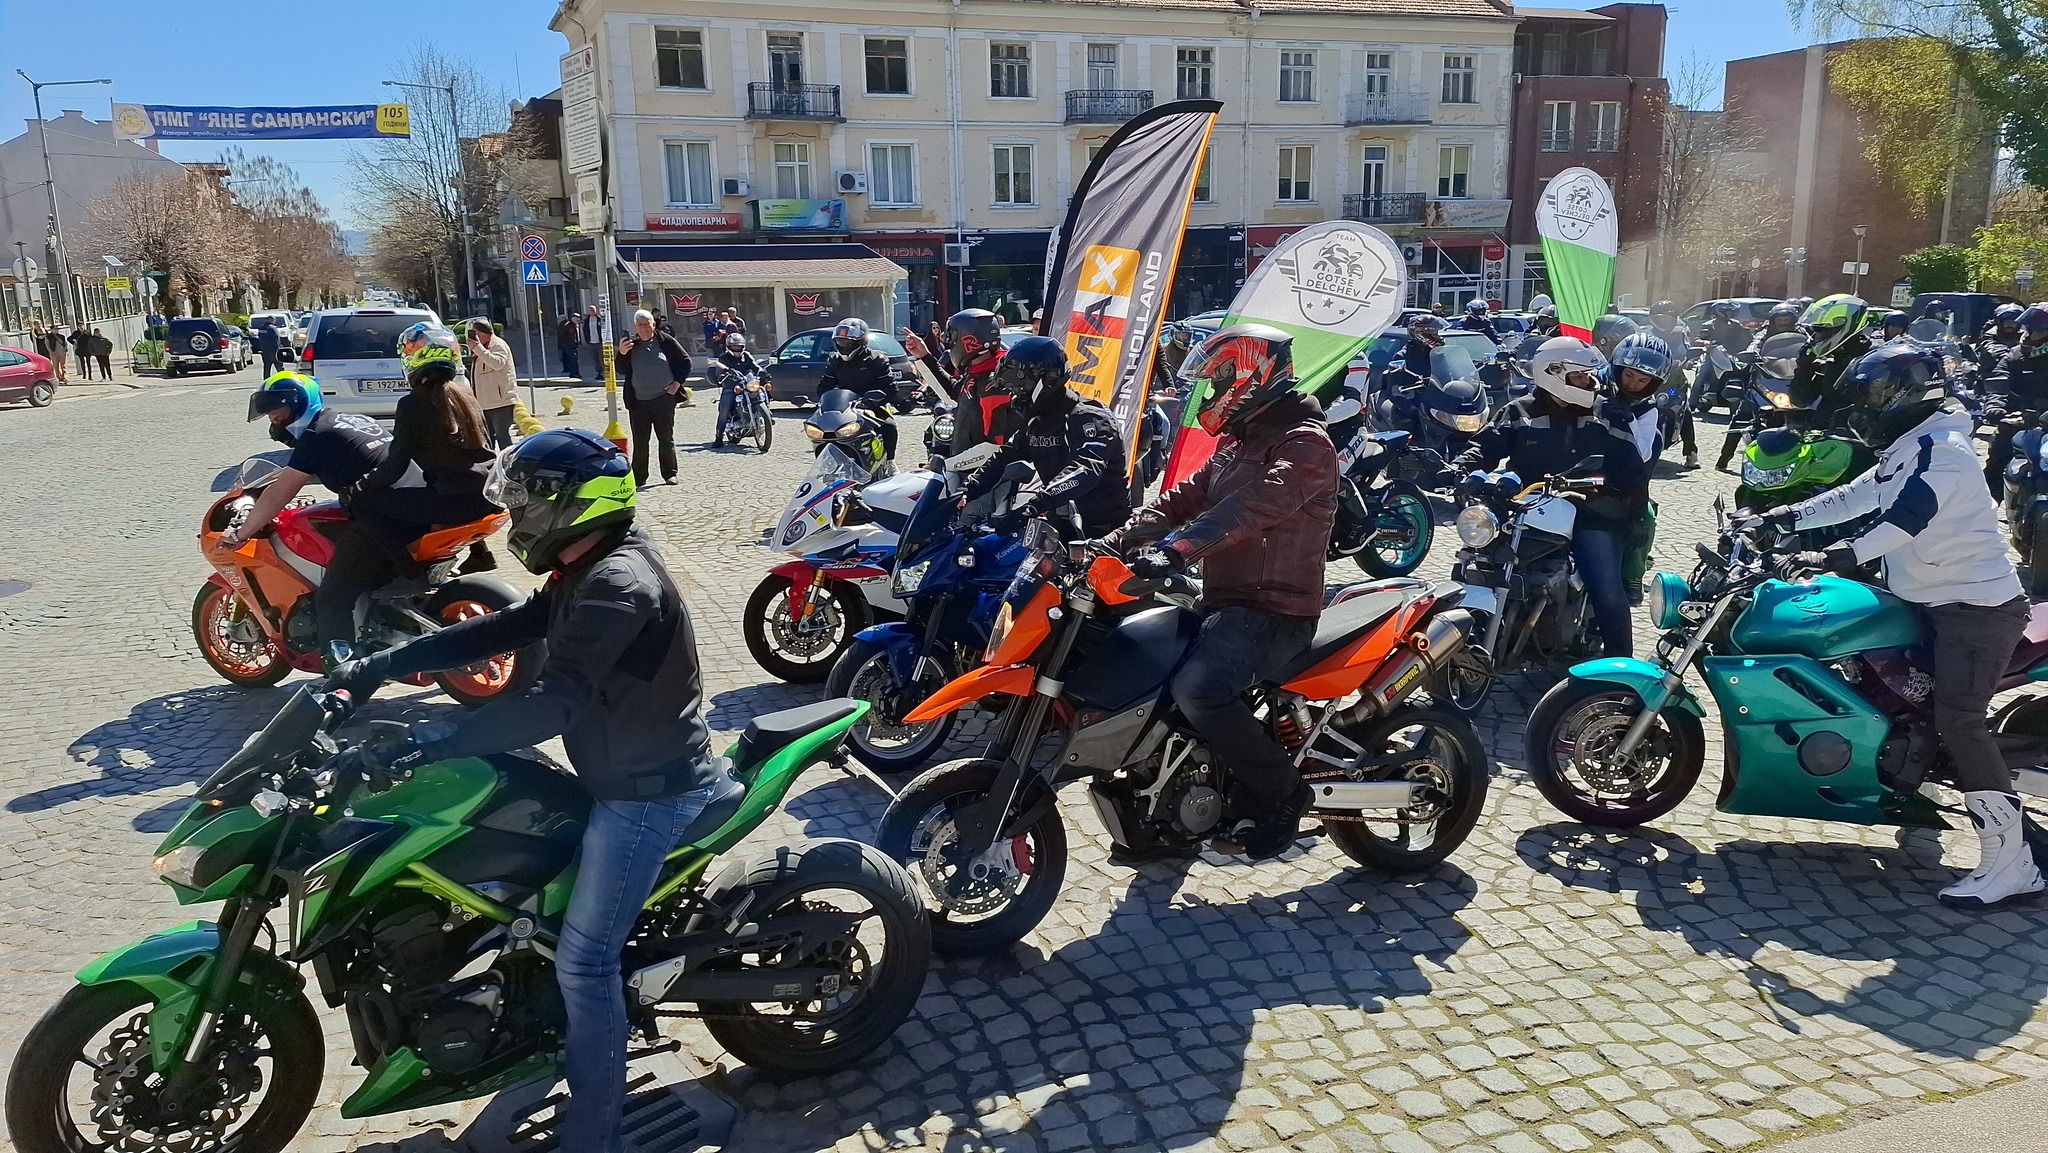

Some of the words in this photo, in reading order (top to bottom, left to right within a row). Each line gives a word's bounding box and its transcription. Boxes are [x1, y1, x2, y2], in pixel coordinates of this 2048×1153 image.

[153, 111, 193, 127] ПМГ
[383, 107, 403, 119] 105
[660, 216, 727, 227] СЛАДКОПЕКАРНА
[1336, 233, 1356, 243] TEAM
[1317, 272, 1354, 287] GOTSE
[1306, 279, 1361, 297] DELCHEV
[1071, 251, 1123, 385] MAX
[1119, 376, 1135, 399] IN
[1127, 252, 1163, 370] HOLLAND
[366, 381, 373, 390] E
[377, 380, 396, 389] 1927
[1882, 387, 1907, 413] SHARK
[611, 487, 632, 497] SHAR
[796, 482, 812, 498] 9
[994, 539, 1022, 561] Kawas
[860, 577, 888, 585] HP4
[1976, 798, 2002, 827] Forma
